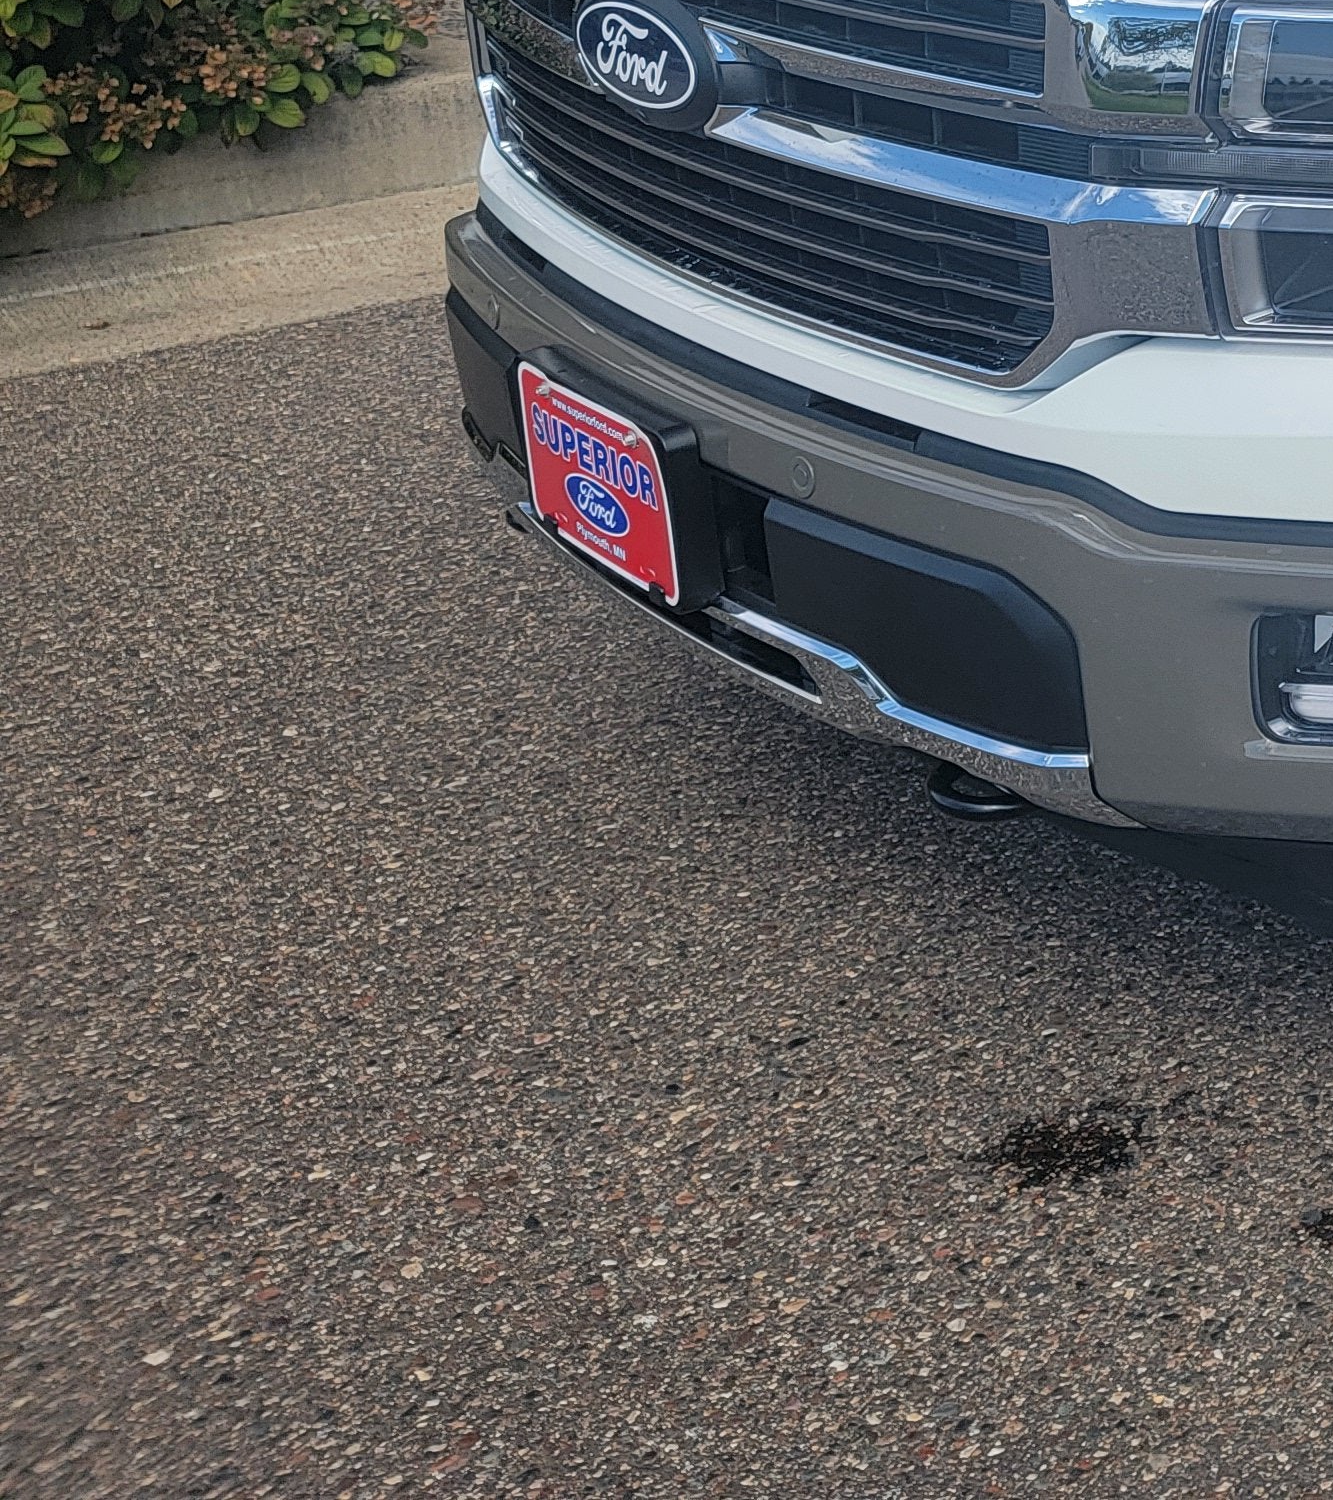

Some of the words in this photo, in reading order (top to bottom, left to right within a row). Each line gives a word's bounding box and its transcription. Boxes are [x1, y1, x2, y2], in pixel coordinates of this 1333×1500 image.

[596, 13, 668, 96] Ford
[531, 401, 659, 512] SUPERIOR
[577, 479, 617, 529] Ford
[612, 543, 627, 562] MN
